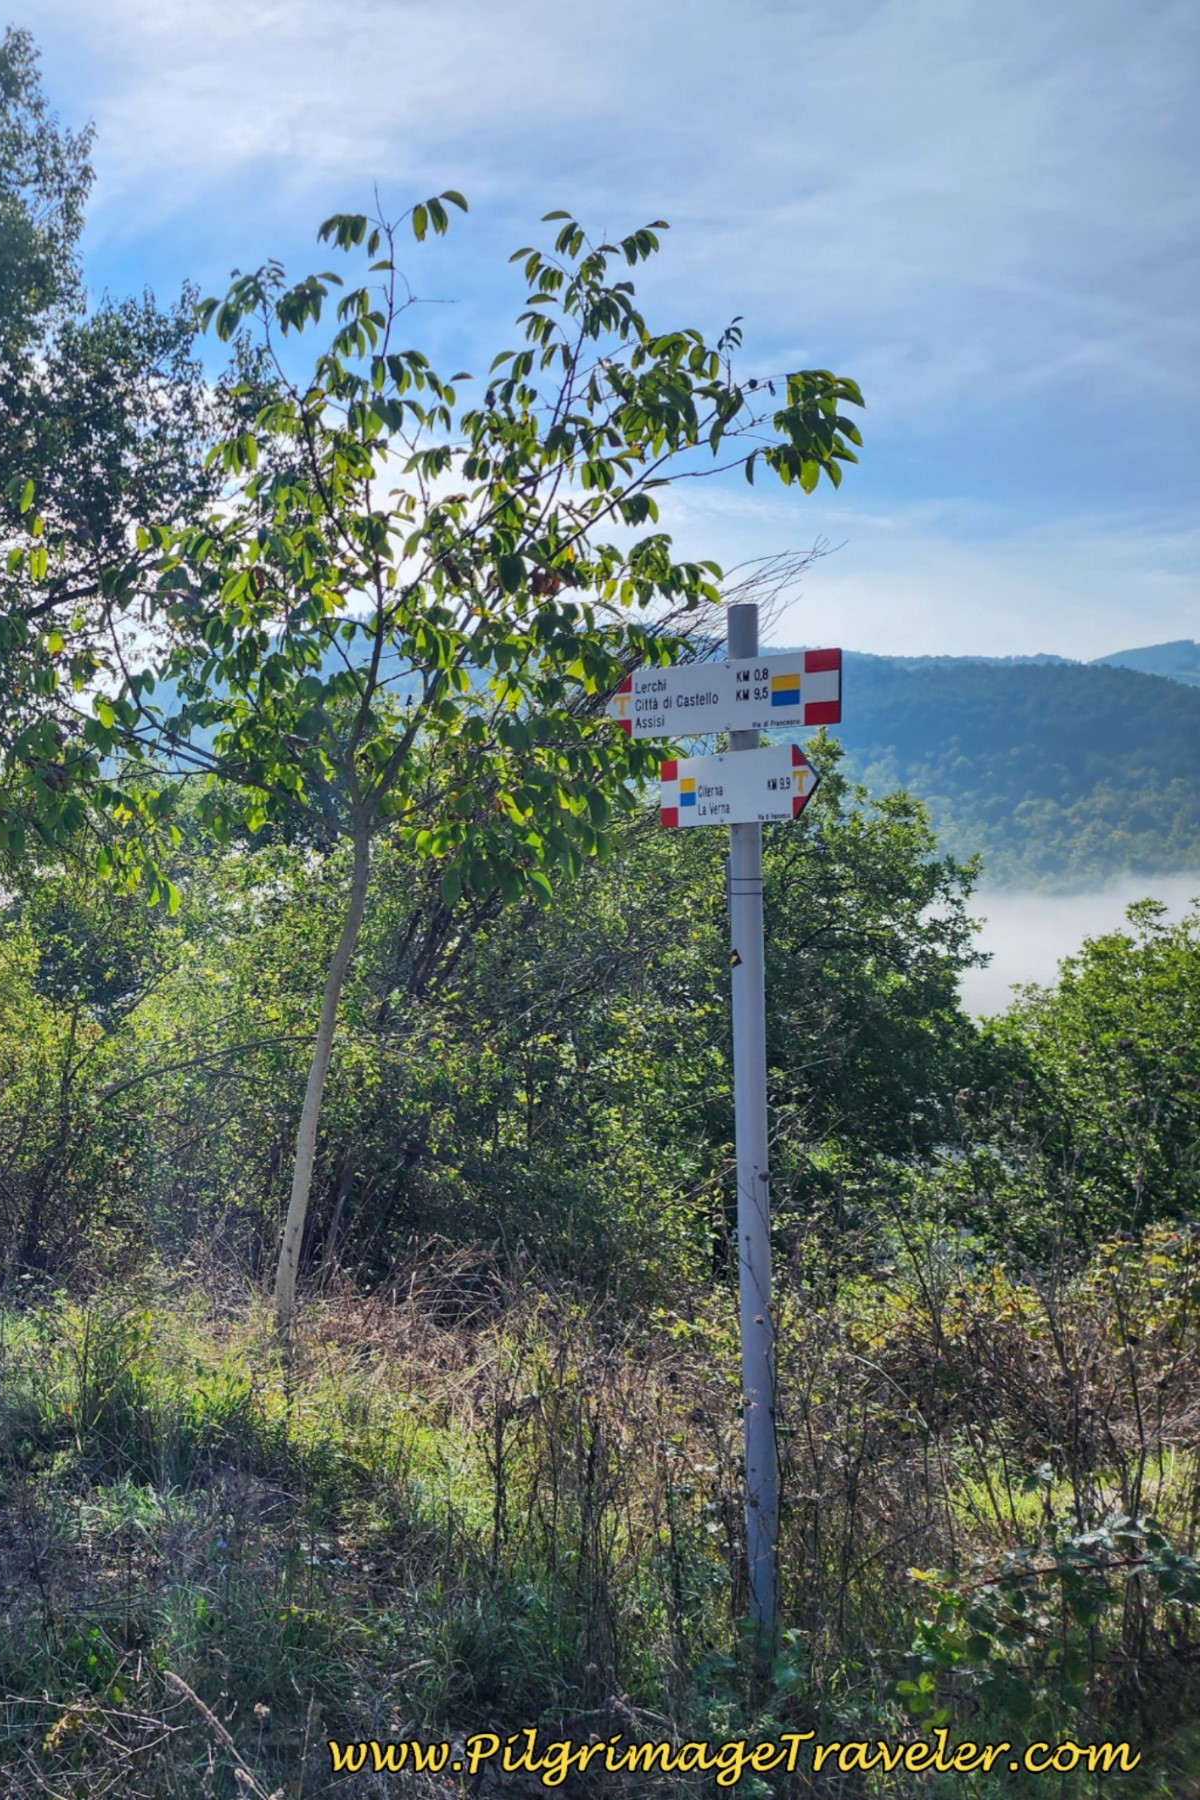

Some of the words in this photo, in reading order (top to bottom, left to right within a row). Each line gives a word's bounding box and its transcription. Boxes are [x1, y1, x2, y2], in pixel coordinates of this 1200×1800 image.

[736, 669, 750, 683] KM
[635, 679, 667, 694] Lerchi
[635, 696, 659, 711] Città
[663, 694, 673, 709] di
[676, 692, 719, 708] Castello
[736, 688, 750, 702] KM
[635, 715, 665, 729] Assisi
[697, 785, 724, 798] Citerna
[698, 803, 707, 816] La
[709, 802, 730, 815] Verna
